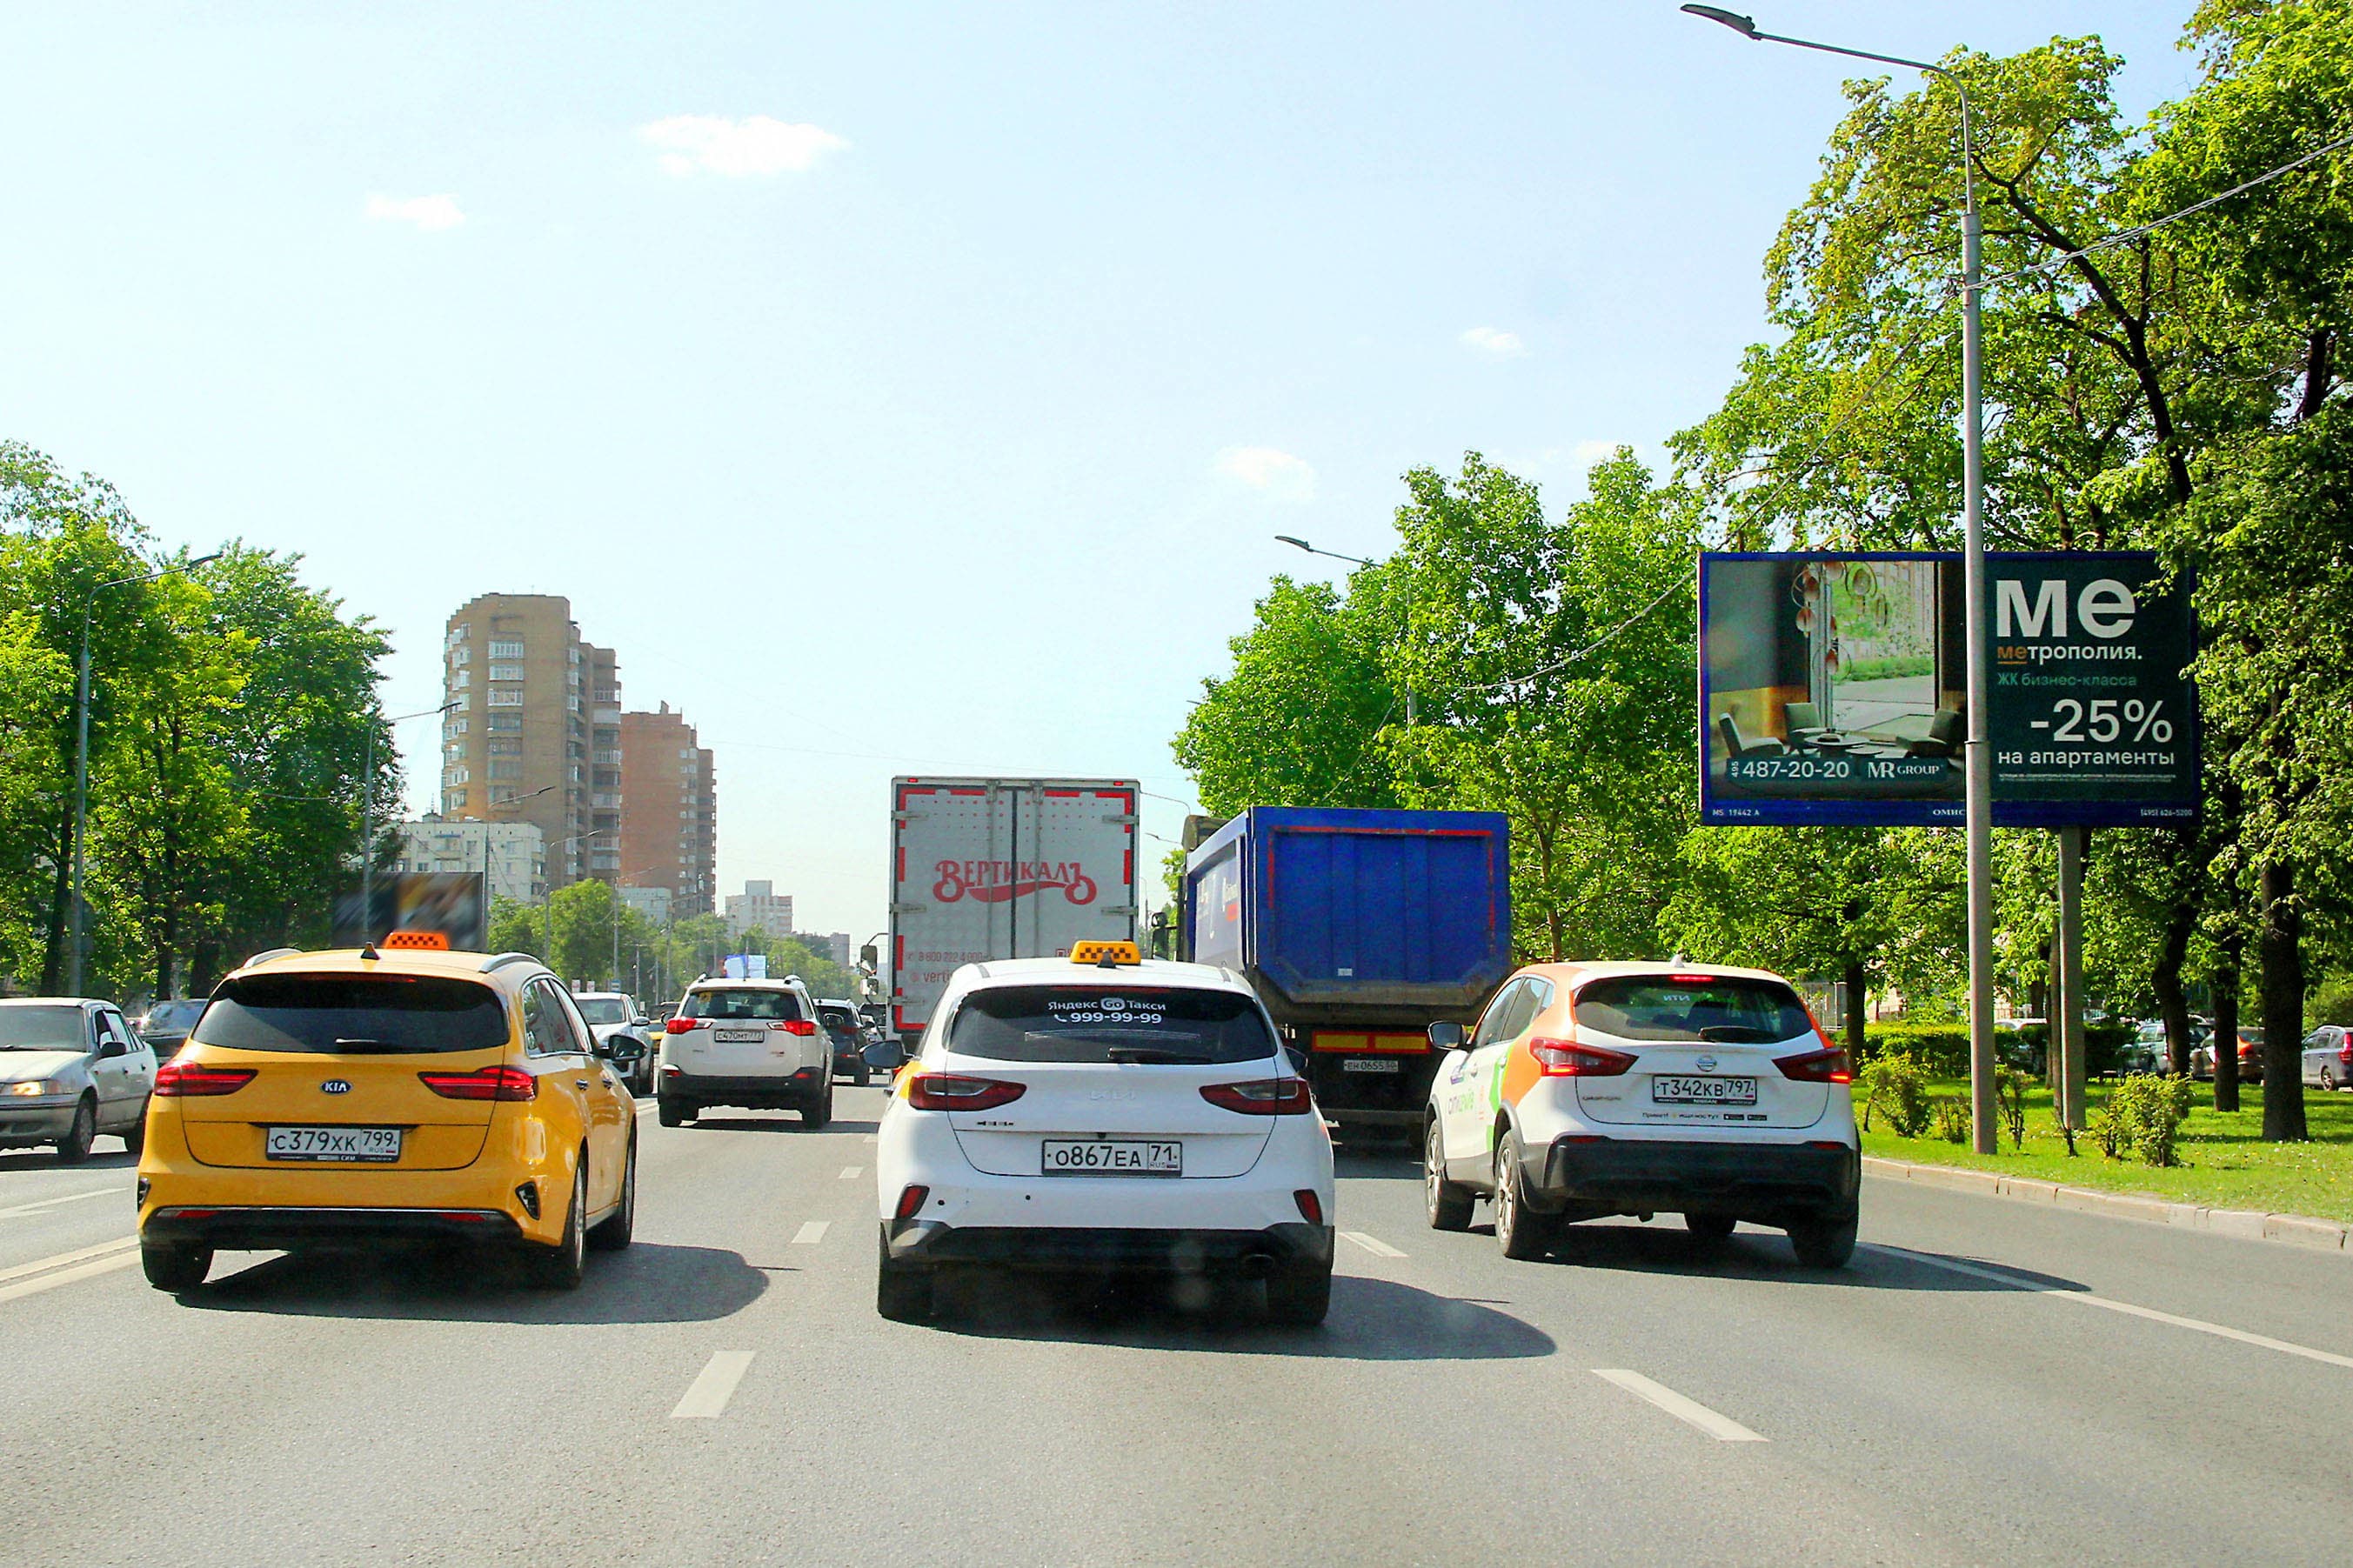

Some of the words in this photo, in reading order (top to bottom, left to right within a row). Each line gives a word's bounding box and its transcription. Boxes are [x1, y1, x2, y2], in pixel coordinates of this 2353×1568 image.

[1995, 578, 2136, 639] ме
[1996, 646, 2143, 665] метрополия.
[1997, 673, 2018, 686] ЖК
[2021, 673, 2137, 686] бизнес-класса
[2030, 698, 2173, 743] -25%
[1998, 751, 2022, 764] на
[2029, 751, 2175, 768] апартаменты
[1741, 761, 1850, 778] 487-20-20
[1868, 762, 1895, 778] MR
[1897, 765, 1940, 775] GROUP
[1047, 1001, 1099, 1011] Яндекс
[1101, 999, 1124, 1010] Go
[1126, 1000, 1166, 1011] Такси
[1071, 1012, 1162, 1024] 999-99-99
[324, 1082, 347, 1091] KIA
[1660, 1079, 1723, 1097] Т342КВ
[1726, 1081, 1750, 1093] 797
[274, 1131, 357, 1152] С379ХК
[363, 1131, 394, 1147] 799
[1055, 1145, 1141, 1167] О867ЕА
[1151, 1145, 1173, 1162] 71
